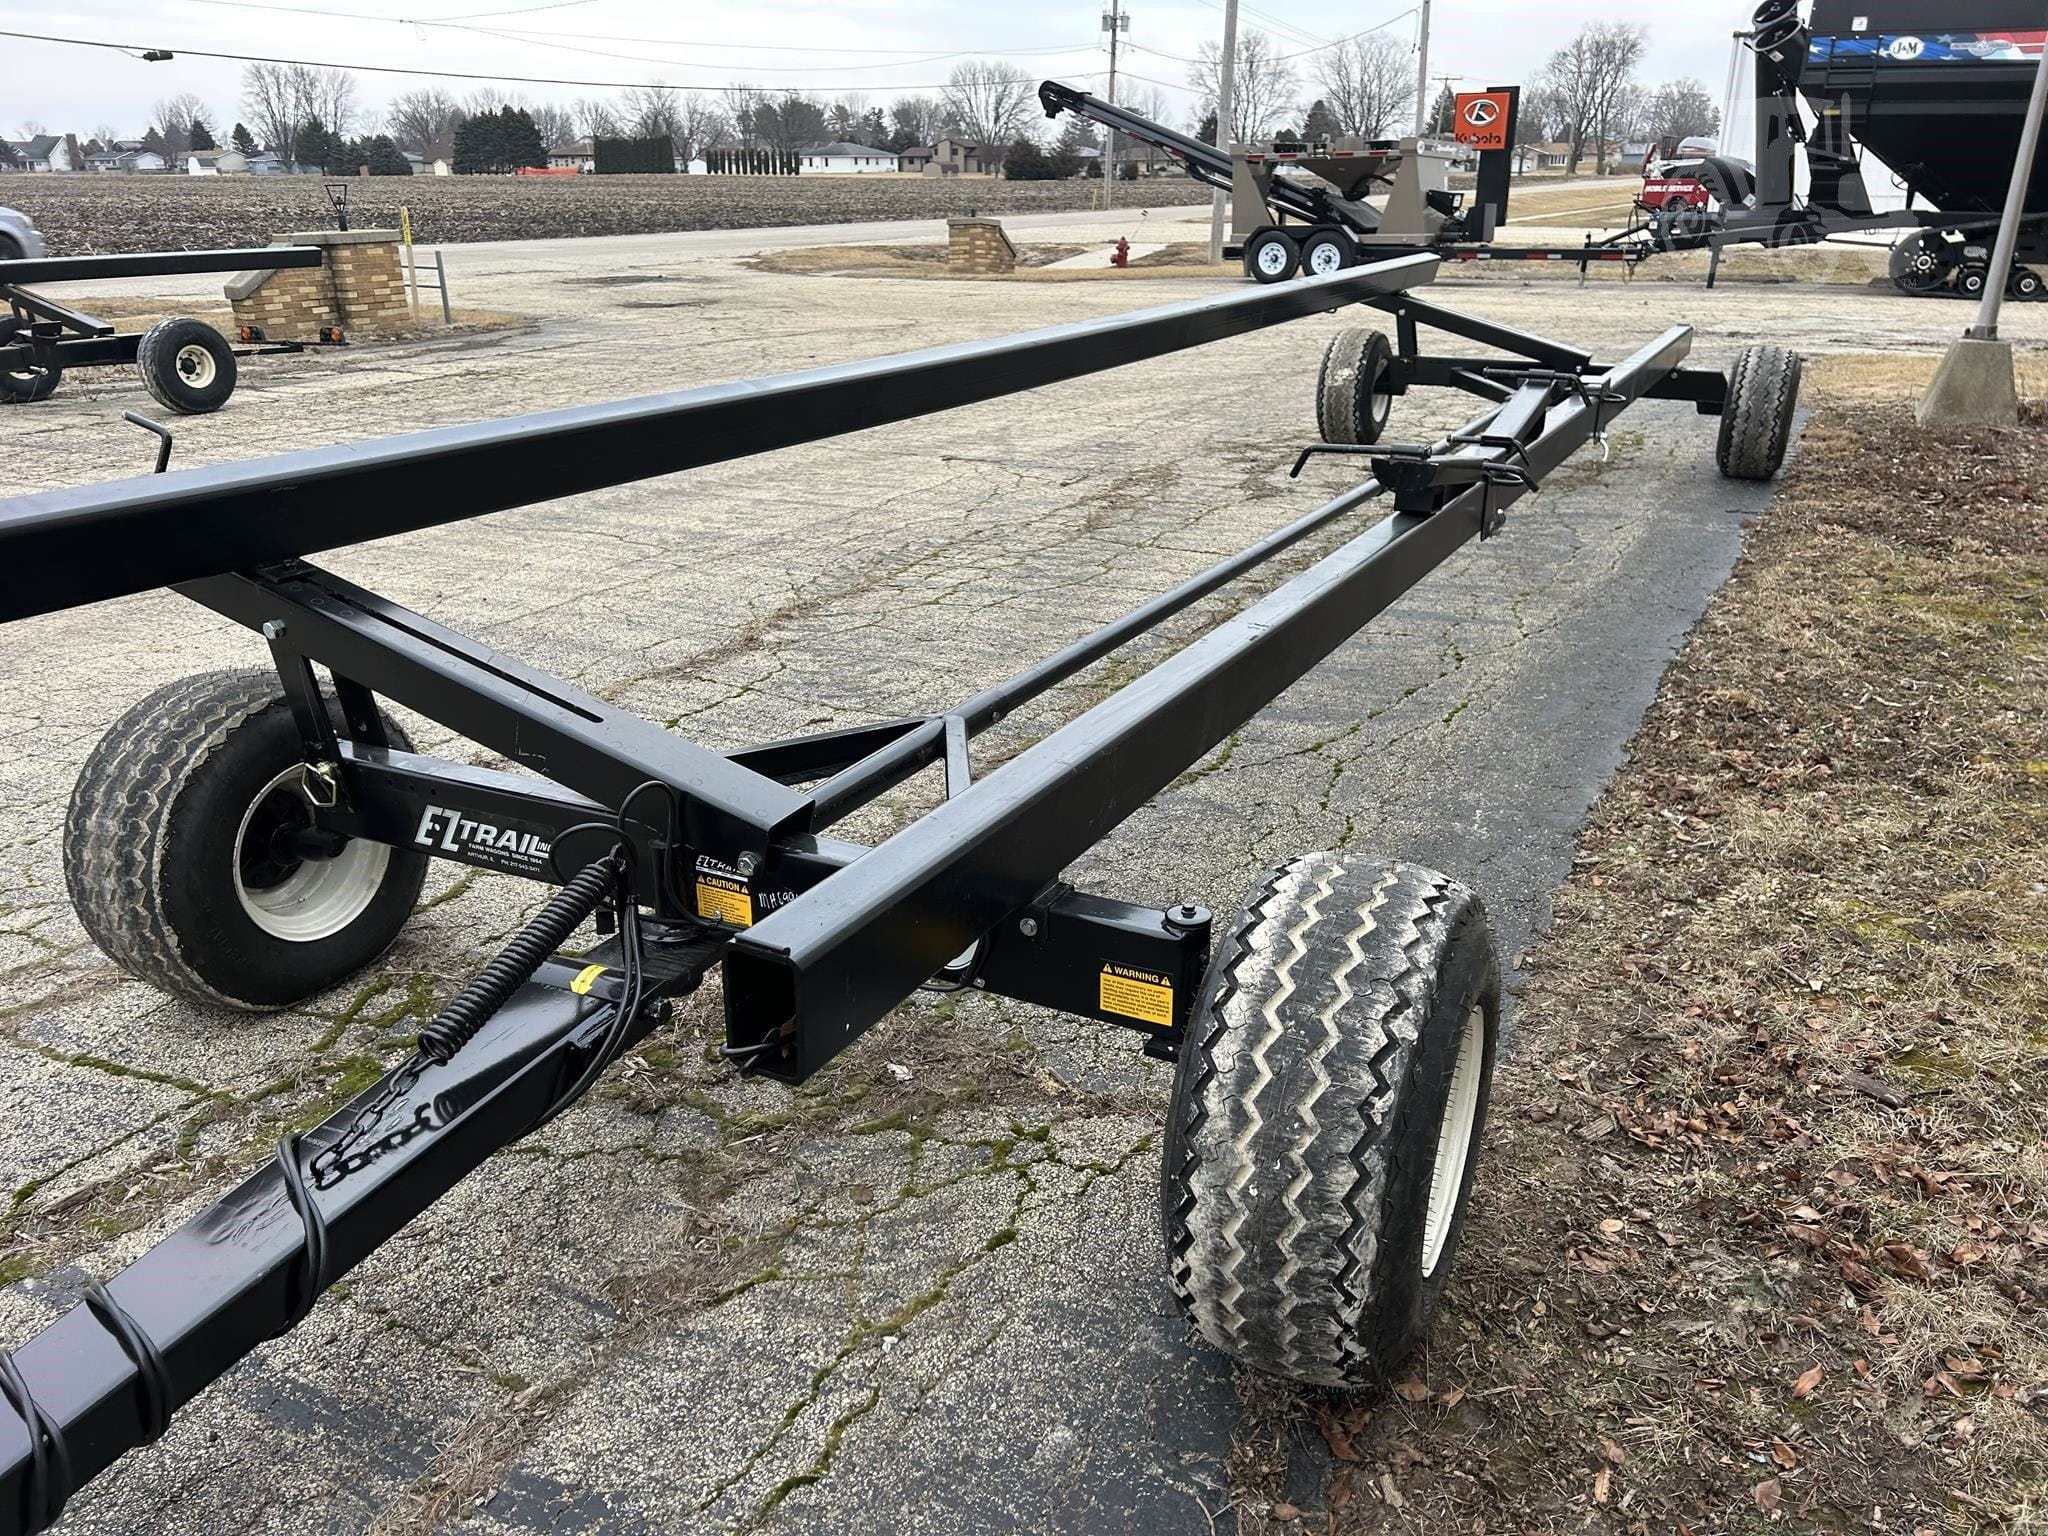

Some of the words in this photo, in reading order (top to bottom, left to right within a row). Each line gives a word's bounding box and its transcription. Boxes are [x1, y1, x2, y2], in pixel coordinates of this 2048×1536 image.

[1893, 42, 1918, 54] J&M
[460, 820, 550, 858] TRAIL
[468, 842, 484, 851] FARM
[485, 846, 510, 856] WAGONS
[512, 853, 528, 862] SINCE
[706, 876, 740, 892] CAUTION
[1114, 966, 1159, 983] WARNING
